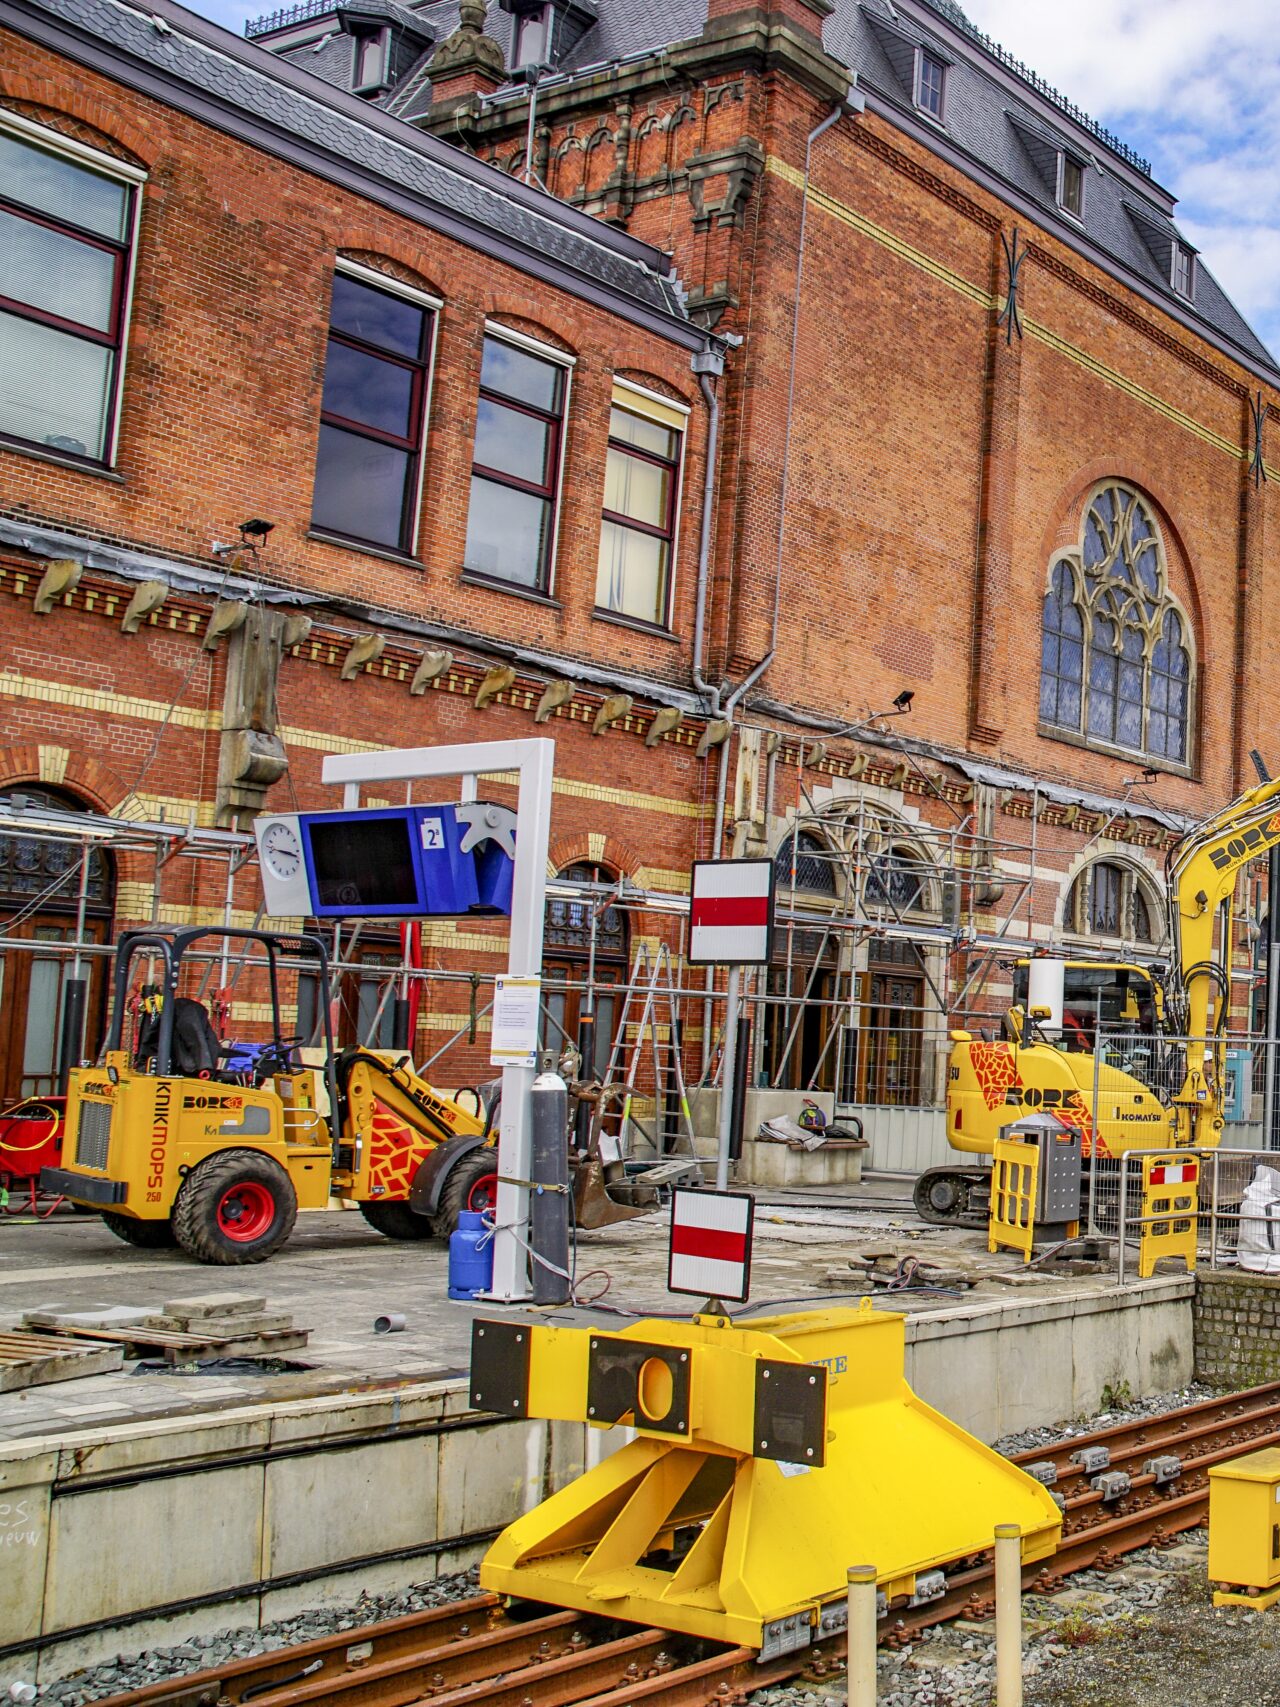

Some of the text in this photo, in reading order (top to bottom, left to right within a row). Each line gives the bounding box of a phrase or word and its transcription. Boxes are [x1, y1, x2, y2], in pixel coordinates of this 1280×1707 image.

[1225, 856, 1244, 869] KUNST
[183, 1096, 233, 1109] BORK
[1006, 1087, 1081, 1109] BORK
[1121, 1112, 1161, 1122] KOMATSU
[146, 1192, 162, 1202] 250
